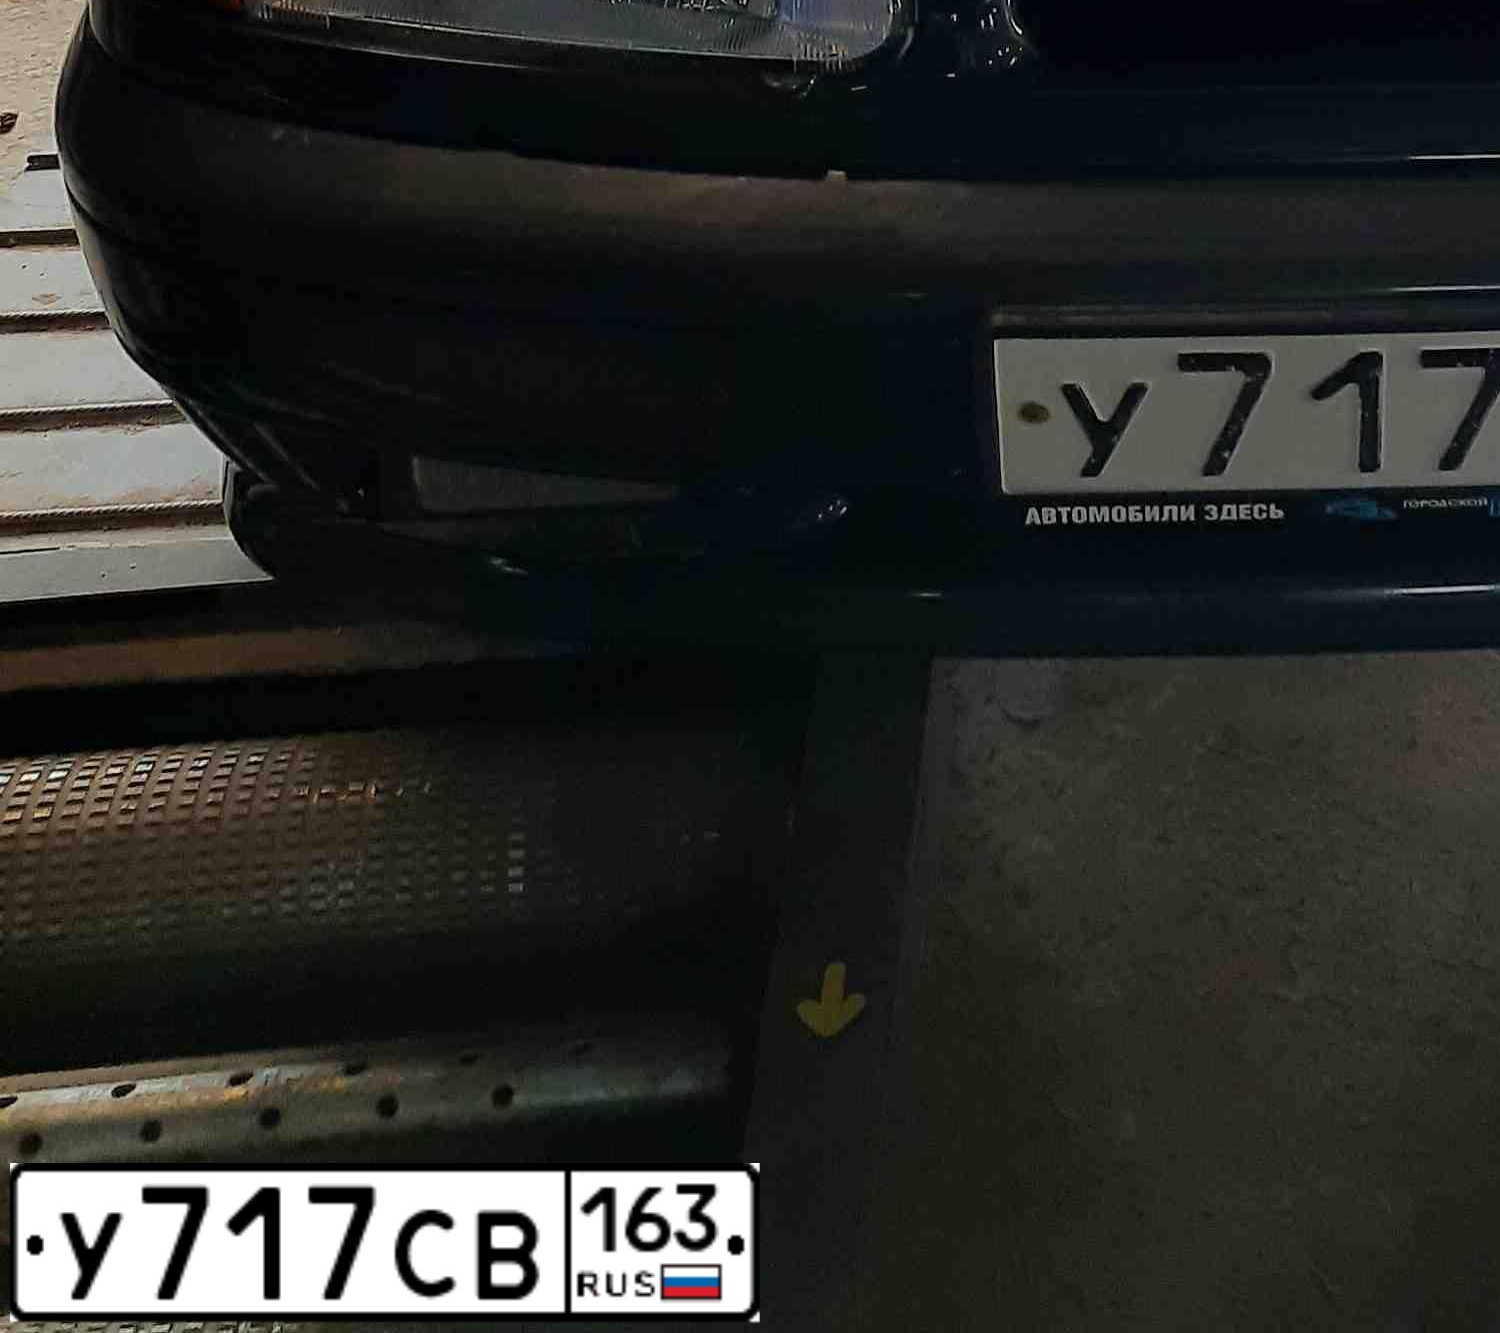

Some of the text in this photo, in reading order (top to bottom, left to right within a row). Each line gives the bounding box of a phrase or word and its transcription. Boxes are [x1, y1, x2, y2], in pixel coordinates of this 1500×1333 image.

[1403, 496, 1488, 509] ГОРОДСКОЙ
[1025, 502, 1285, 526] АВТОМОБИЛИ ЗДЕСЬ
